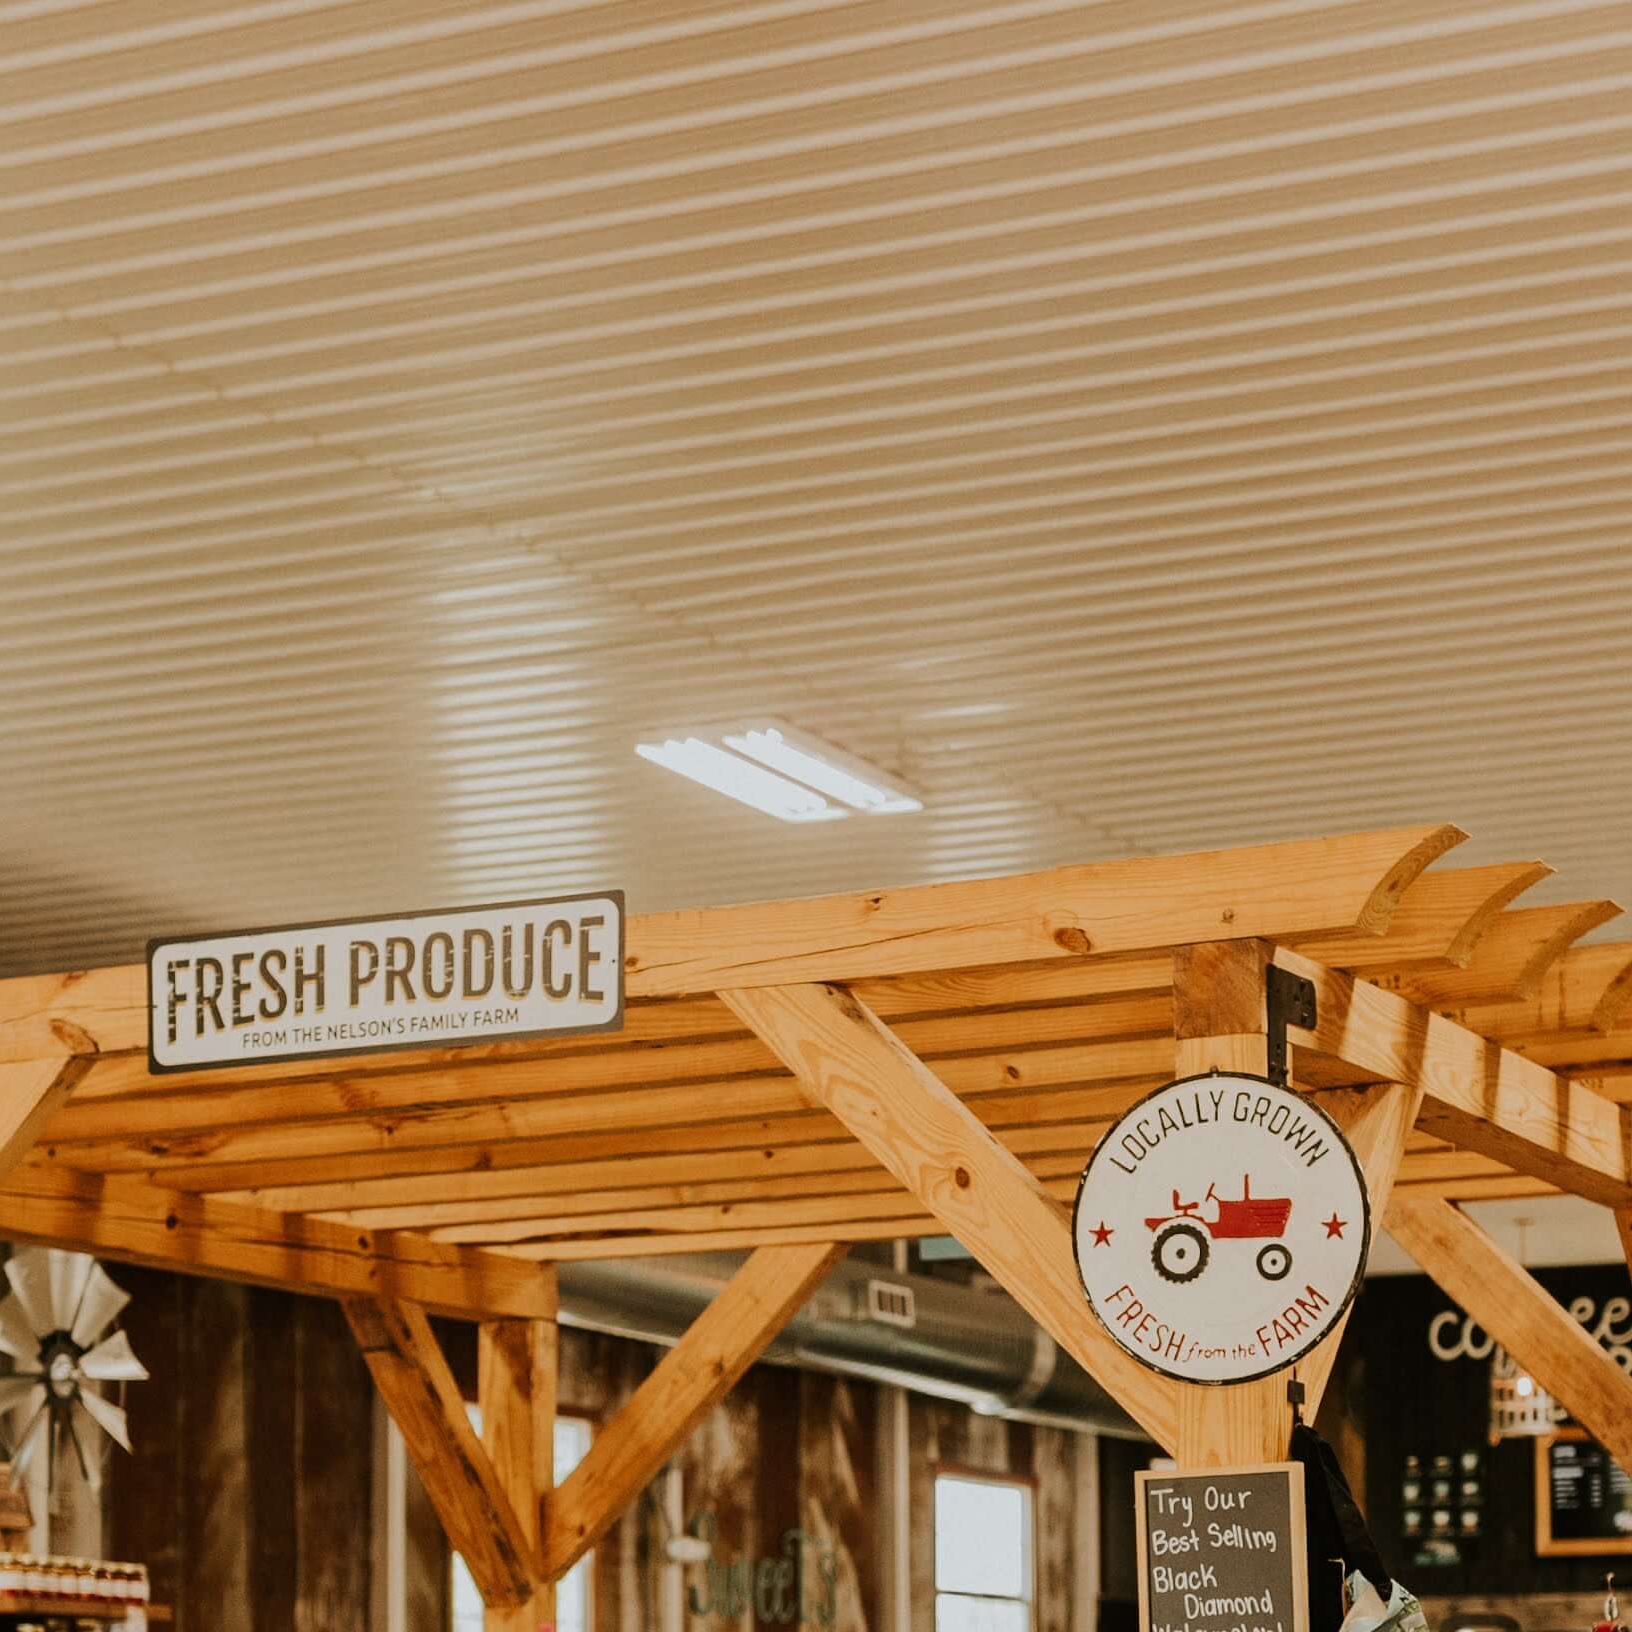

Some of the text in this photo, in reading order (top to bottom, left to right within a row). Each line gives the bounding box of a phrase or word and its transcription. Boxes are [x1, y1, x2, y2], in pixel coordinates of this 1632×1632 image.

[167, 915, 606, 1046] FRESH PRODUCE
[242, 1008, 520, 1049] FROM THE NELSON'S FAMILY FARM
[1110, 1090, 1330, 1173] LOCALLY GROWN
[1105, 1284, 1330, 1363] FRESH from the FARM
[1150, 1486, 1252, 1527] Try Our
[1152, 1522, 1277, 1556] Best Selling
[1153, 1563, 1217, 1593] Black
[1184, 1588, 1274, 1619] Diamond
